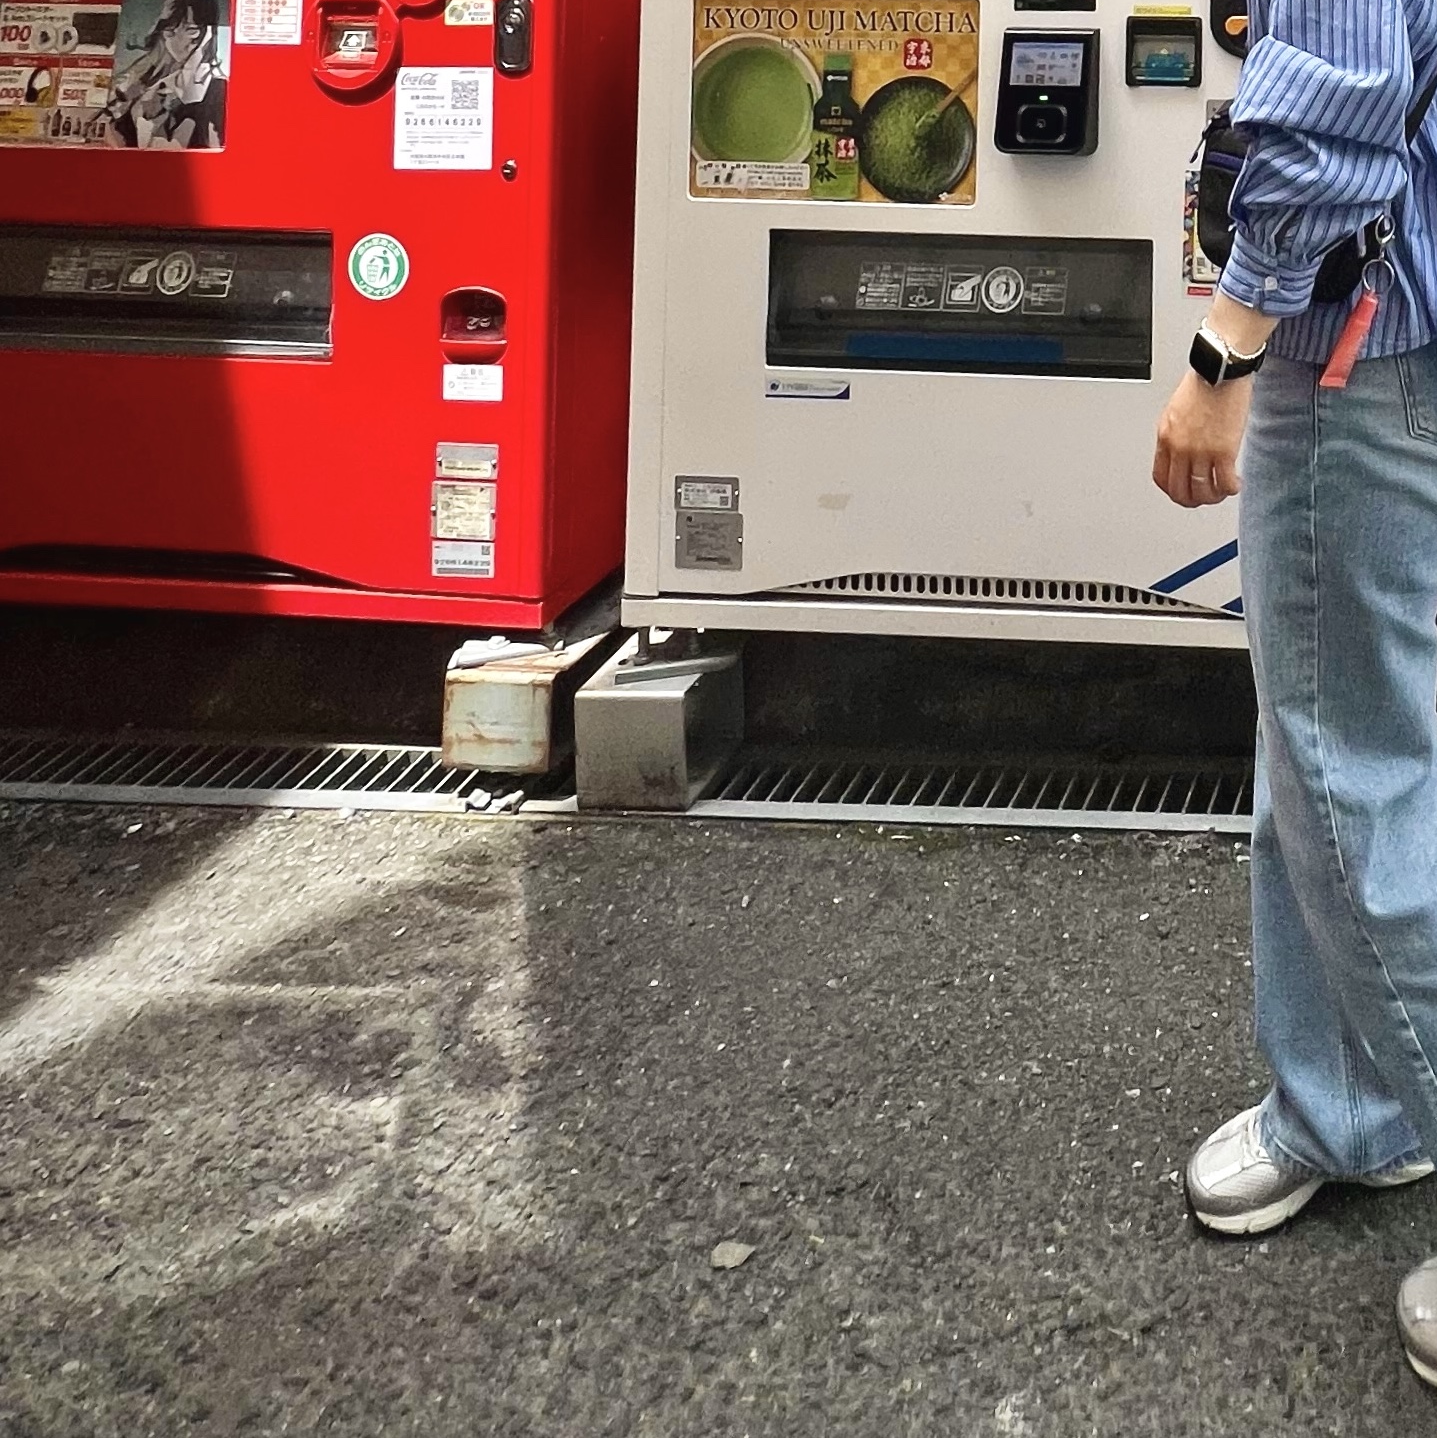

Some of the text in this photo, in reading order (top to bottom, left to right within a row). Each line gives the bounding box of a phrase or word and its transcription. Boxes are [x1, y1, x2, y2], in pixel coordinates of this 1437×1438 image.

[703, 7, 978, 36] KYOTO UJI MATCHA
[780, 37, 900, 52] UNSWEETENED
